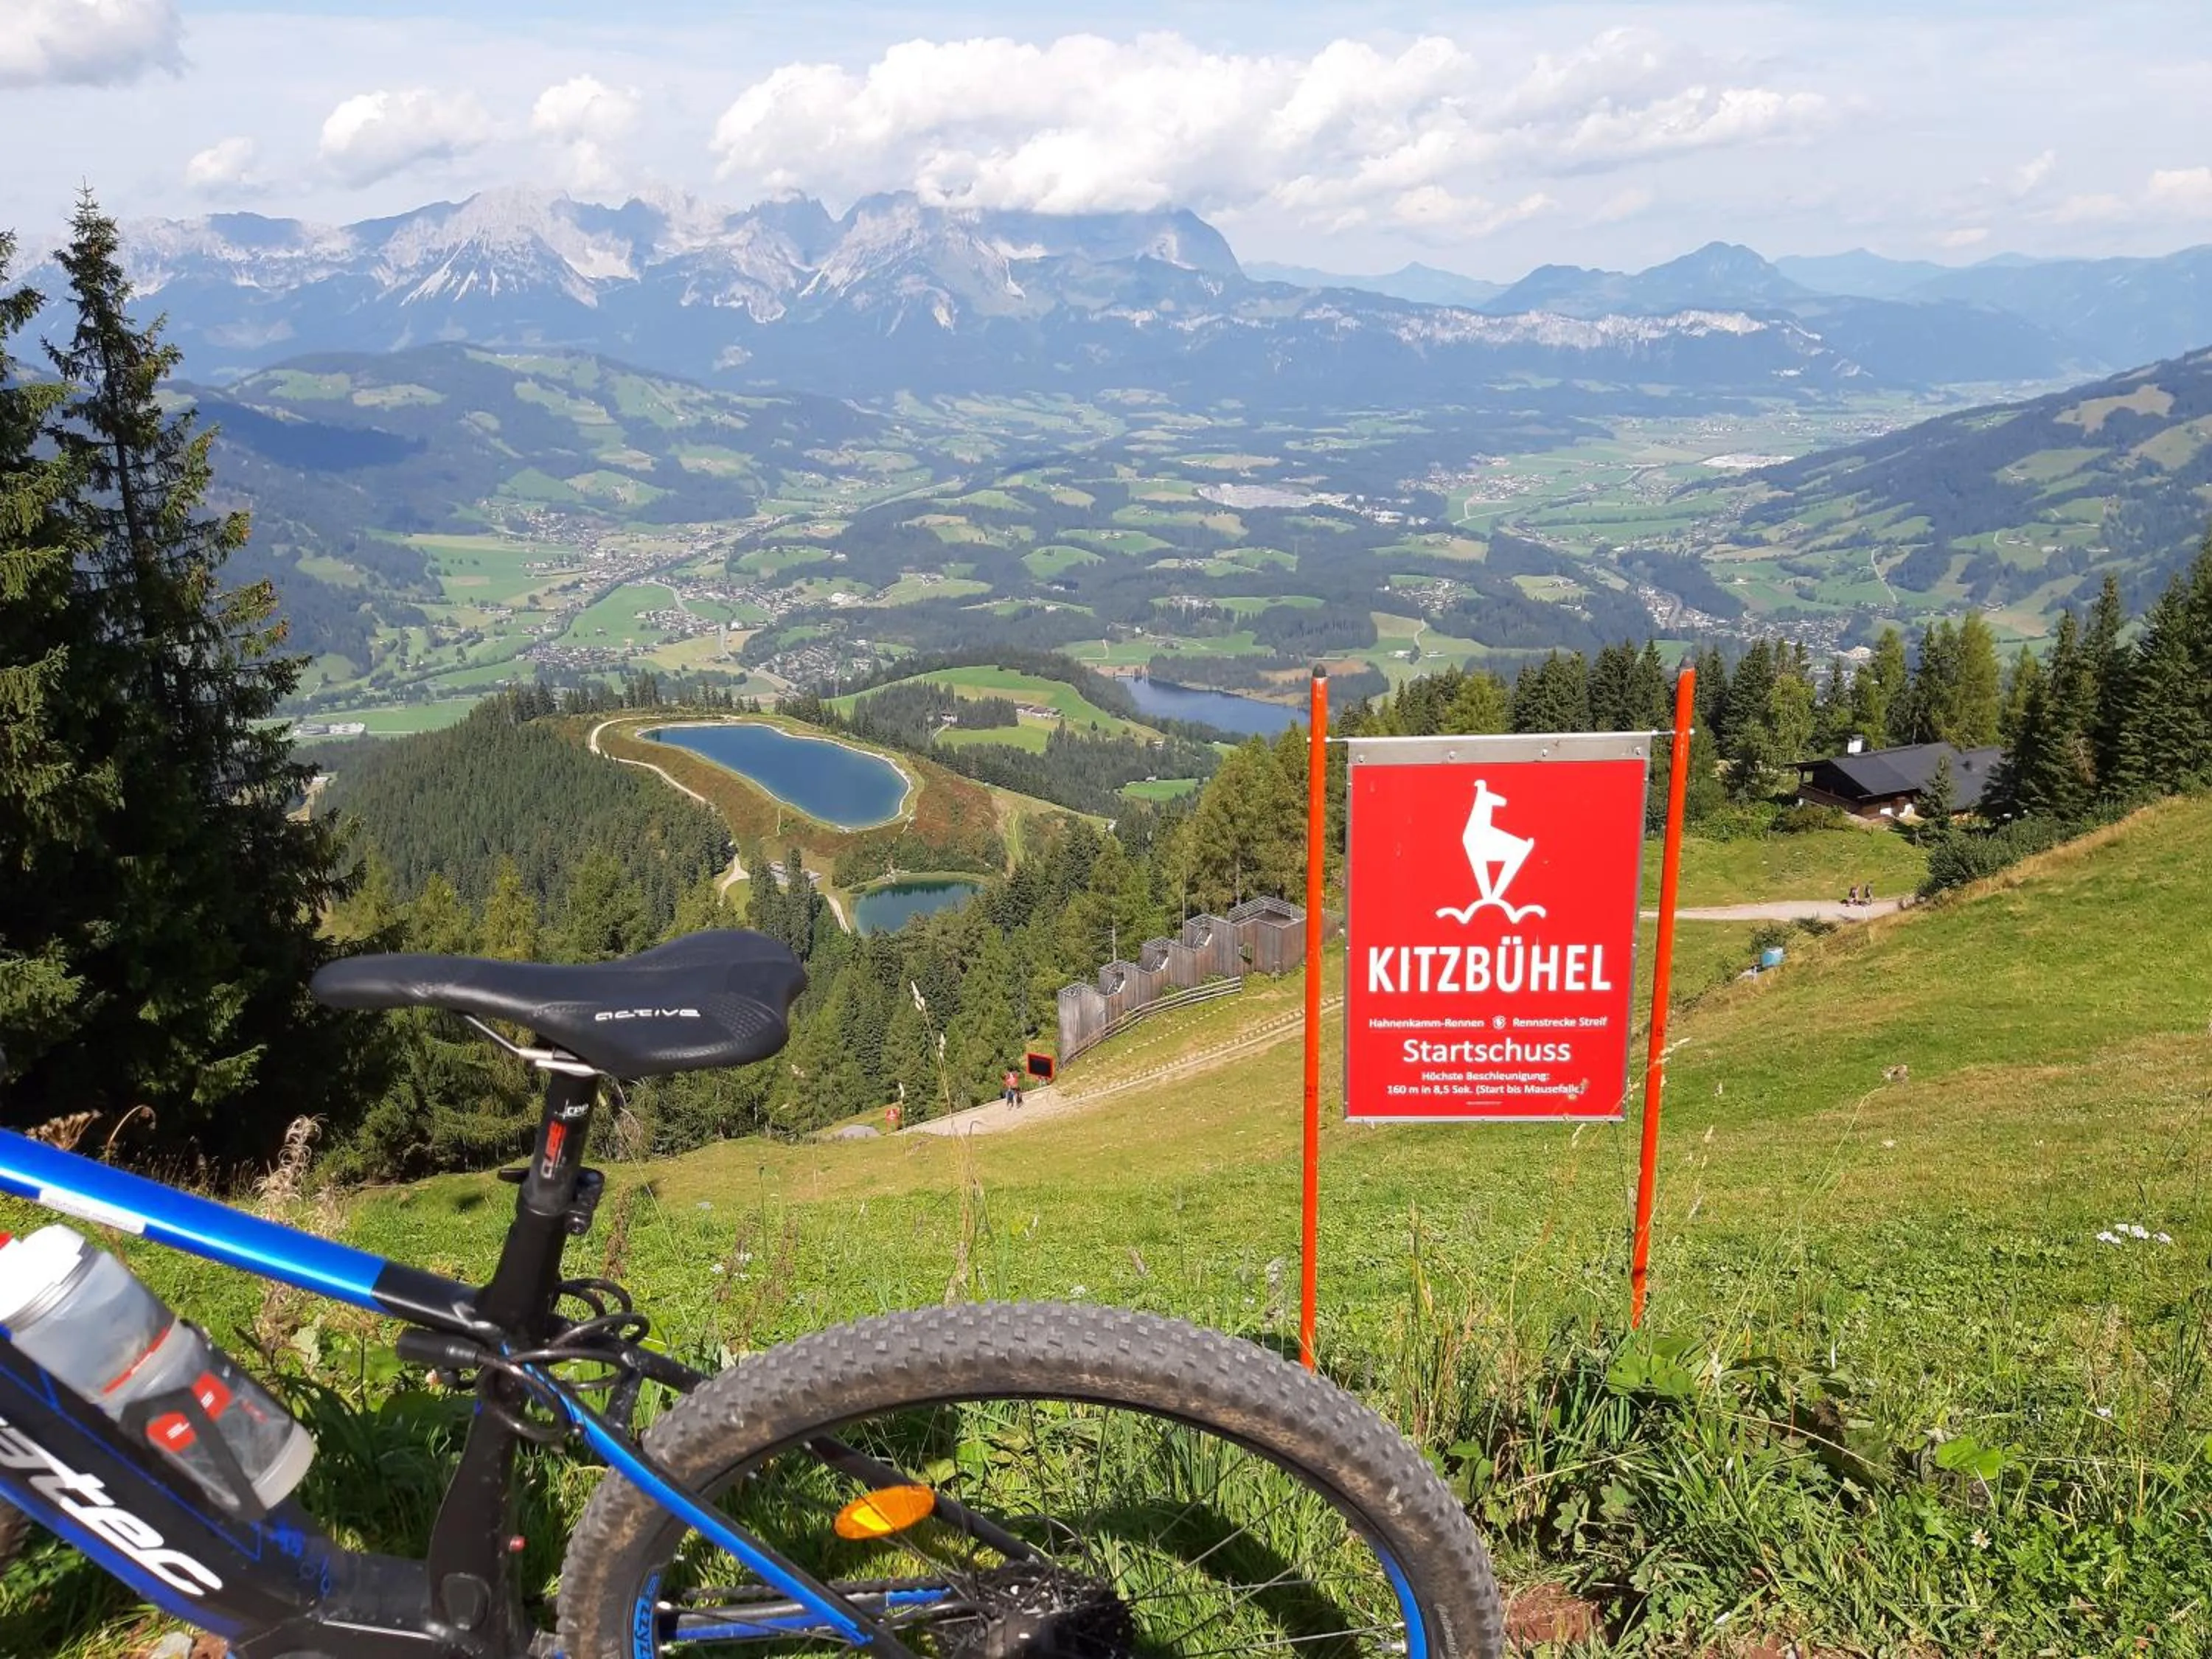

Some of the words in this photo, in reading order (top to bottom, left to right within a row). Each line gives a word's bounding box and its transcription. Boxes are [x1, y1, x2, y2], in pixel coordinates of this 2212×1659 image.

[1368, 935, 1612, 993] KITZBÜHEL
[1368, 1018, 1485, 1029] Hahnenkamm-Rennen
[1512, 1017, 1576, 1028] Rennstrecke
[1579, 1015, 1608, 1026] Streif
[1402, 1037, 1572, 1062] Startschuss
[1421, 1071, 1464, 1082] Höchste
[1465, 1070, 1550, 1082] Beschleunigung:
[1387, 1085, 1407, 1095] 160
[1408, 1086, 1419, 1094] m
[1421, 1085, 1431, 1095] in
[1433, 1085, 1450, 1095] 8,5
[1475, 1084, 1505, 1096] (Start
[1506, 1084, 1522, 1094] bis
[0, 1416, 223, 1596] atec
